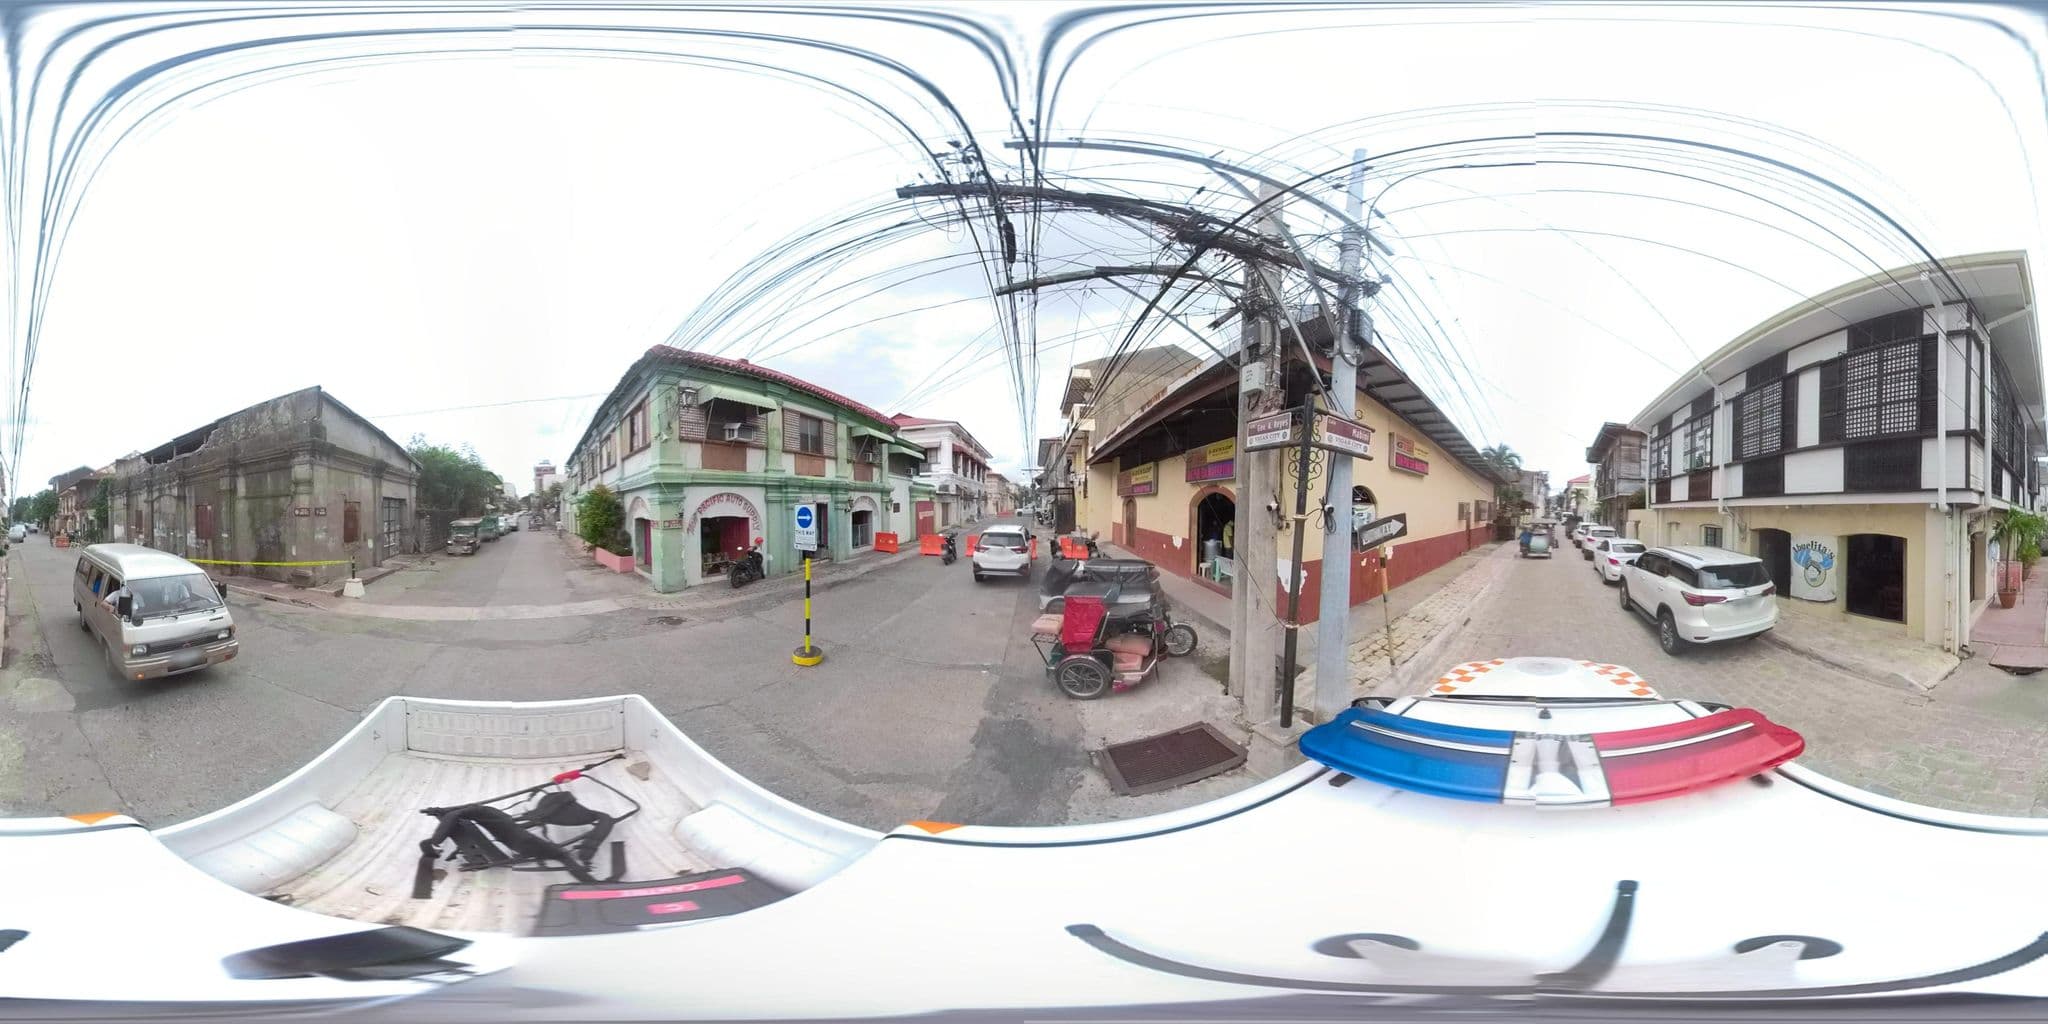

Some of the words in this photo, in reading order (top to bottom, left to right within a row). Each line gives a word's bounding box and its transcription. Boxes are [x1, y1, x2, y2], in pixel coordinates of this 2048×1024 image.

[1336, 437, 1351, 445] VIGAN
[1352, 441, 1362, 449] CITY
[726, 494, 743, 506] AUTO
[742, 502, 760, 532] SUPPLY
